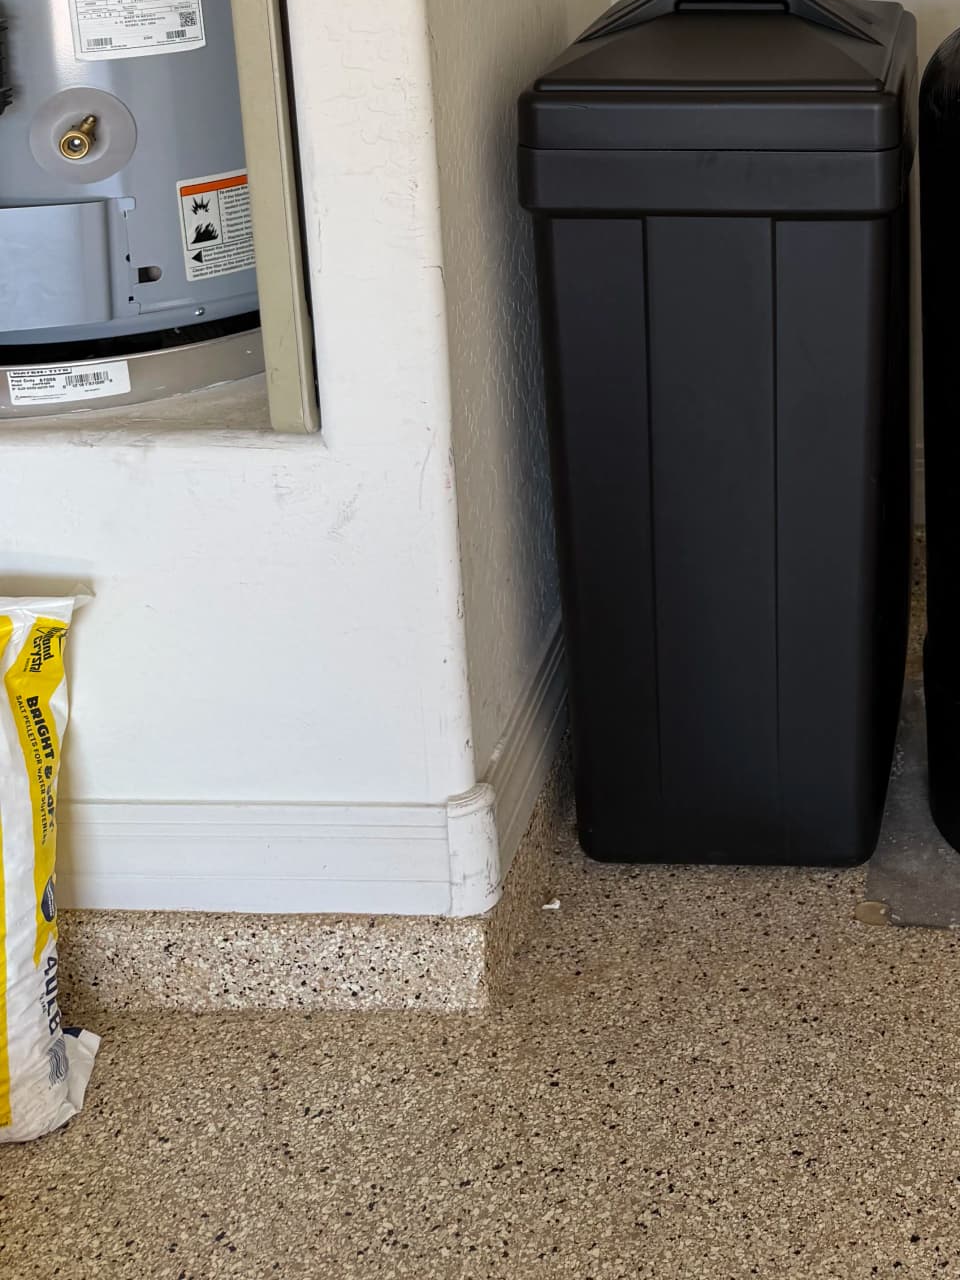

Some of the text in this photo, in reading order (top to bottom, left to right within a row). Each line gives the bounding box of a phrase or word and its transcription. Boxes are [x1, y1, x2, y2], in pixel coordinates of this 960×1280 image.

[16, 695, 26, 714] SALT
[24, 714, 38, 748] PELLETS
[34, 748, 42, 764] FOR
[38, 766, 46, 794] WATER
[26, 696, 54, 759] BRIGHT
